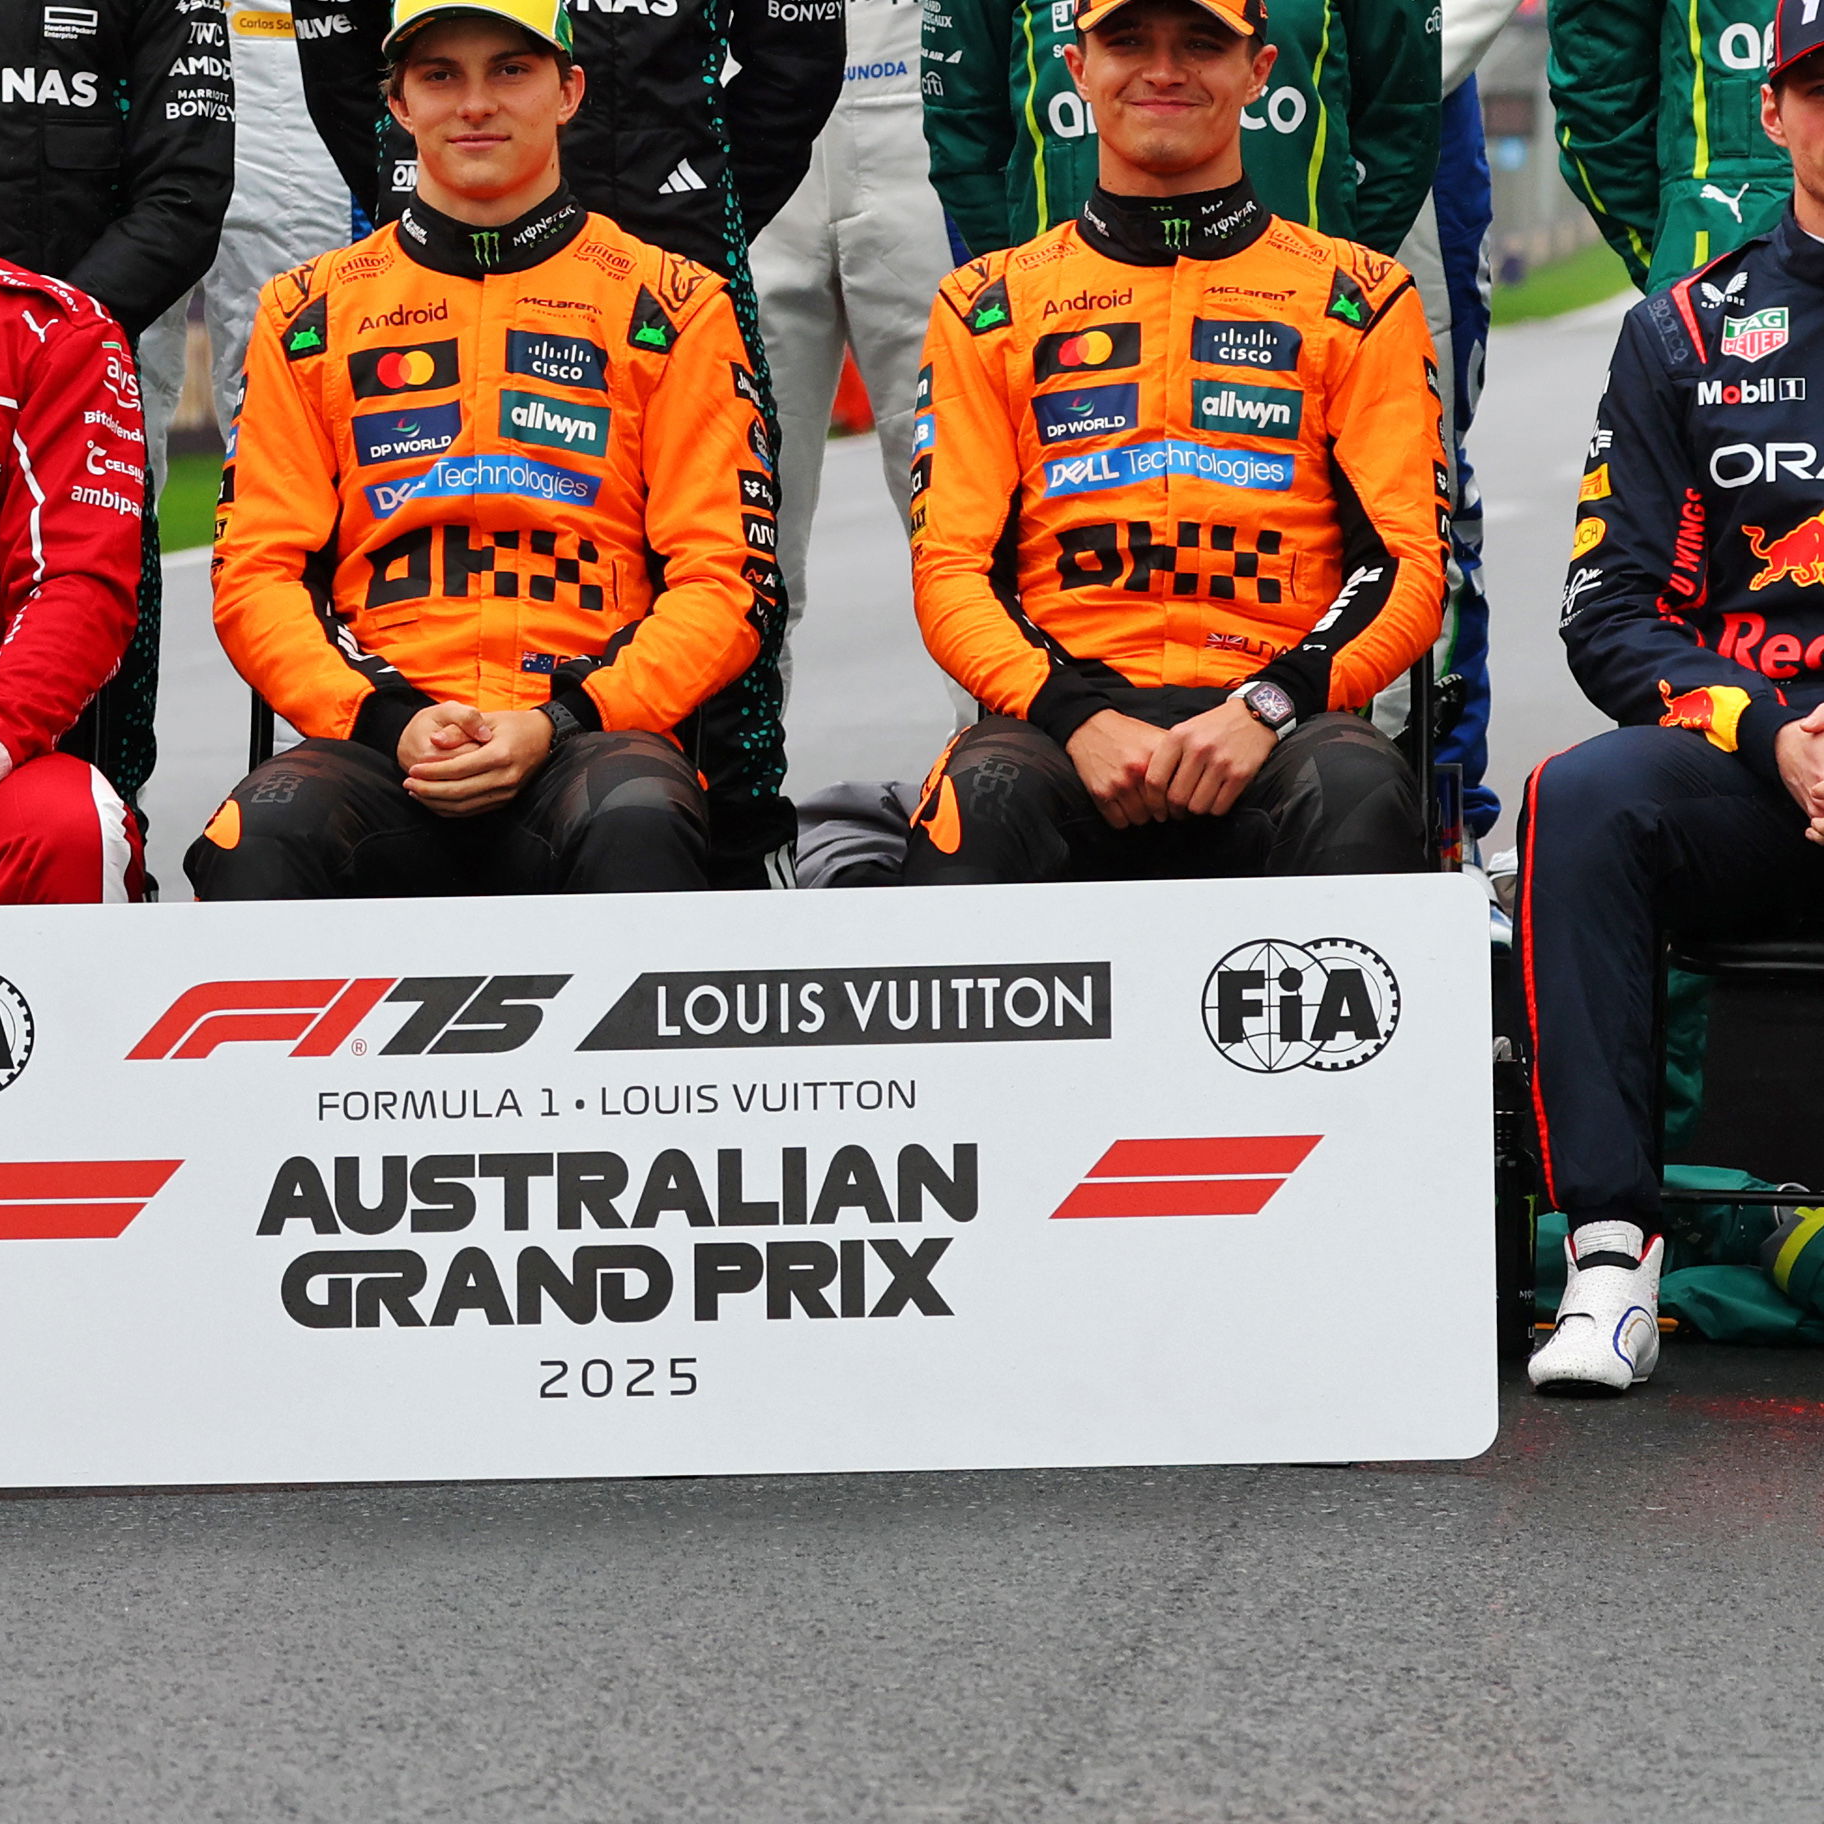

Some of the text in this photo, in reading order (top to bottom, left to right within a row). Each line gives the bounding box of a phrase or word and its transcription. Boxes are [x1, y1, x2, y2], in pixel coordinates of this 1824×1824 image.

[239, 17, 274, 30] Carlos
[768, 0, 843, 21] BONVOY
[357, 298, 448, 336] Android
[1043, 288, 1133, 321] Android
[1728, 312, 1783, 336] TAG
[1219, 346, 1273, 364] CISCO
[1725, 332, 1785, 357] HEUER
[532, 359, 583, 381] CISCO
[1697, 378, 1775, 406] Mobil
[511, 401, 597, 444] allwyn
[1047, 414, 1126, 438] DP WORLD
[1201, 391, 1291, 429] allwyn
[370, 433, 452, 458] DP WORLD
[434, 460, 588, 499] Technologies
[1049, 448, 1284, 488] DELL Technologies
[656, 975, 1094, 1038] LOUIS VUITTON
[319, 1080, 917, 1121] FORMULA 1 LOUIS VUITTON
[256, 1142, 979, 1236] AUSTRALIAN
[281, 1237, 955, 1329] GRAND PRIX
[539, 1356, 698, 1400] 2025
